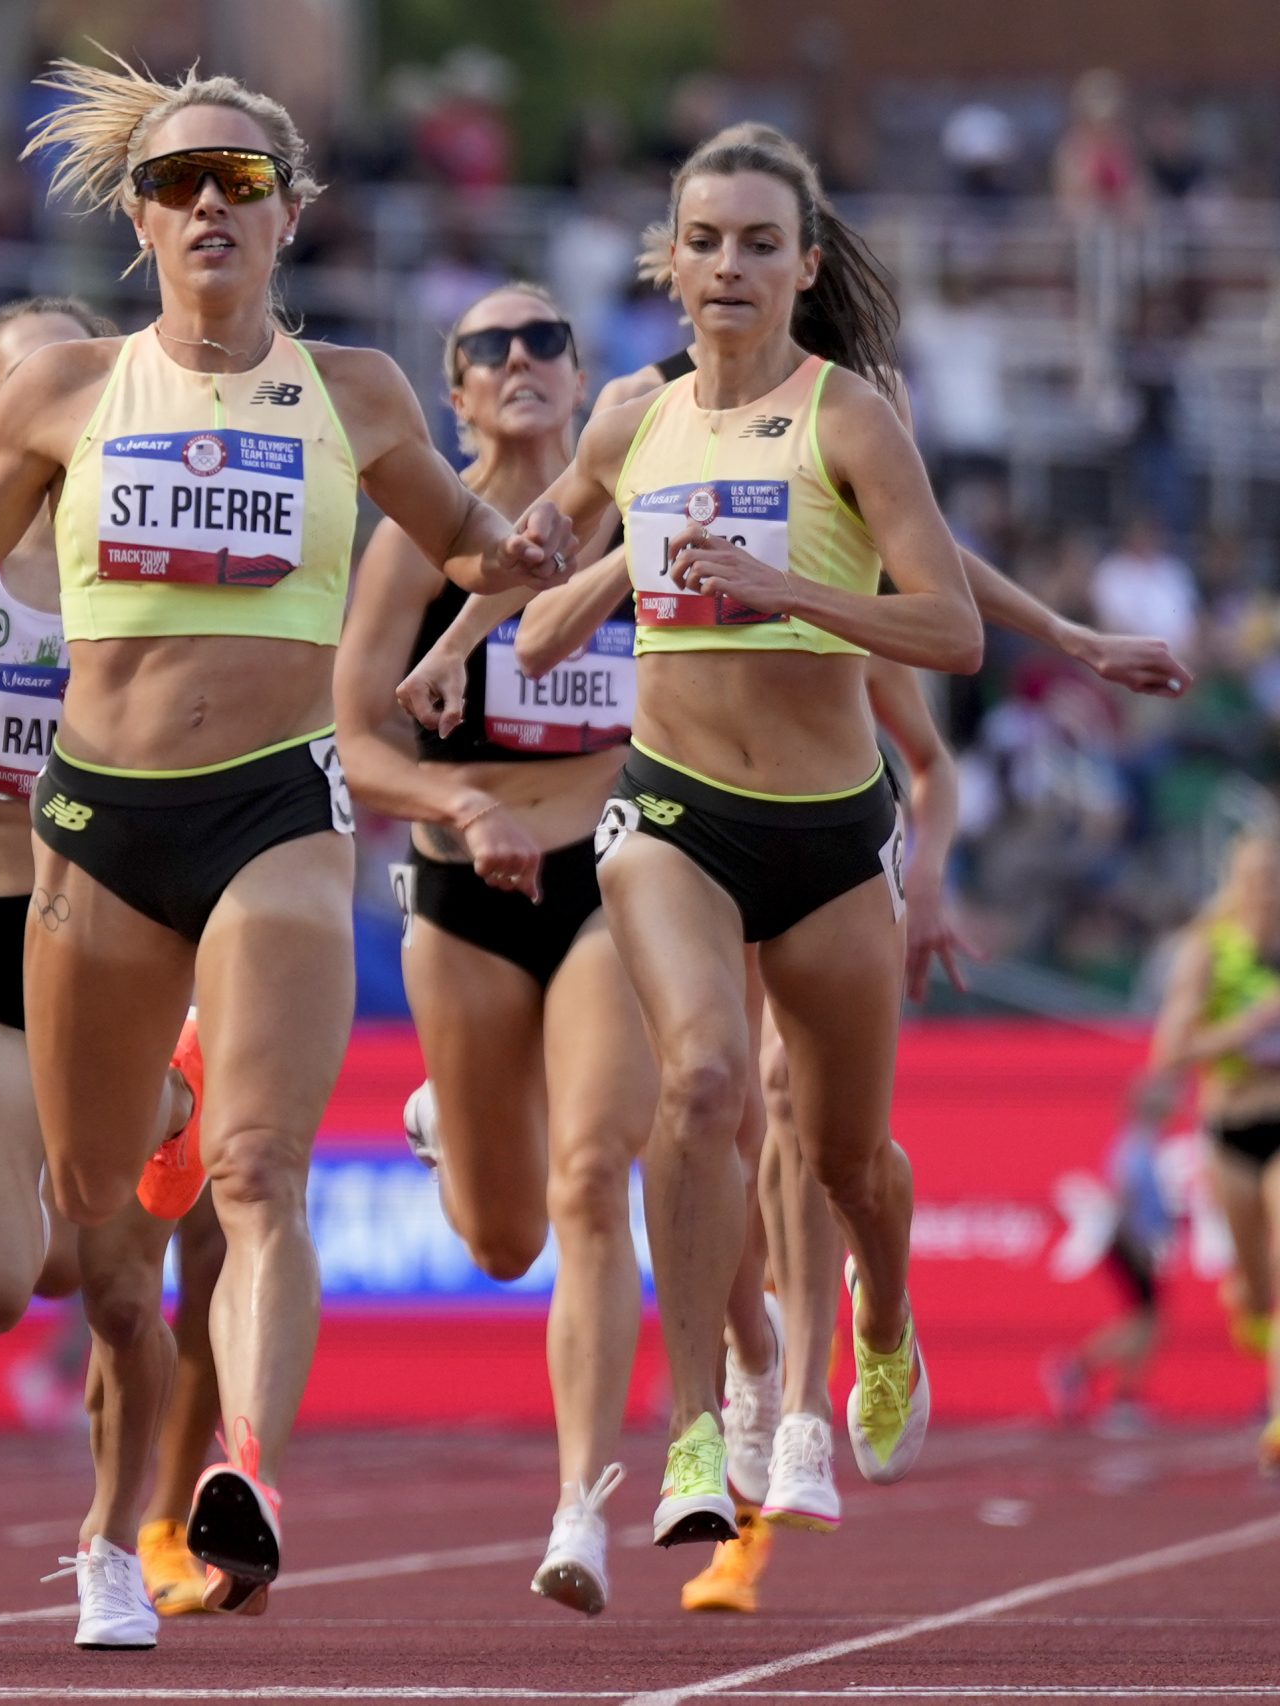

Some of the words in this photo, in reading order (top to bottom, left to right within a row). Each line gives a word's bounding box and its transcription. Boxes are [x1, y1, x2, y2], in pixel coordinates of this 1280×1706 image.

[240, 438, 257, 450] U.S.
[258, 440, 294, 453] OLYMPIC
[240, 448, 263, 461] TEAM
[265, 451, 294, 463] TRIALS
[241, 459, 260, 467] TRACK
[266, 462, 282, 470] FIELD
[731, 486, 745, 495] U.S.
[747, 486, 779, 496] OLYMPIC
[651, 494, 680, 505] USATF
[730, 496, 751, 505] TEAM
[752, 496, 779, 506] TRIALS
[110, 484, 158, 528] ST.
[171, 485, 294, 536] PIERRE
[140, 561, 166, 575] 2024
[17, 678, 53, 688] USATF
[514, 670, 618, 707] TEUBEL
[518, 734, 540, 745] 2024
